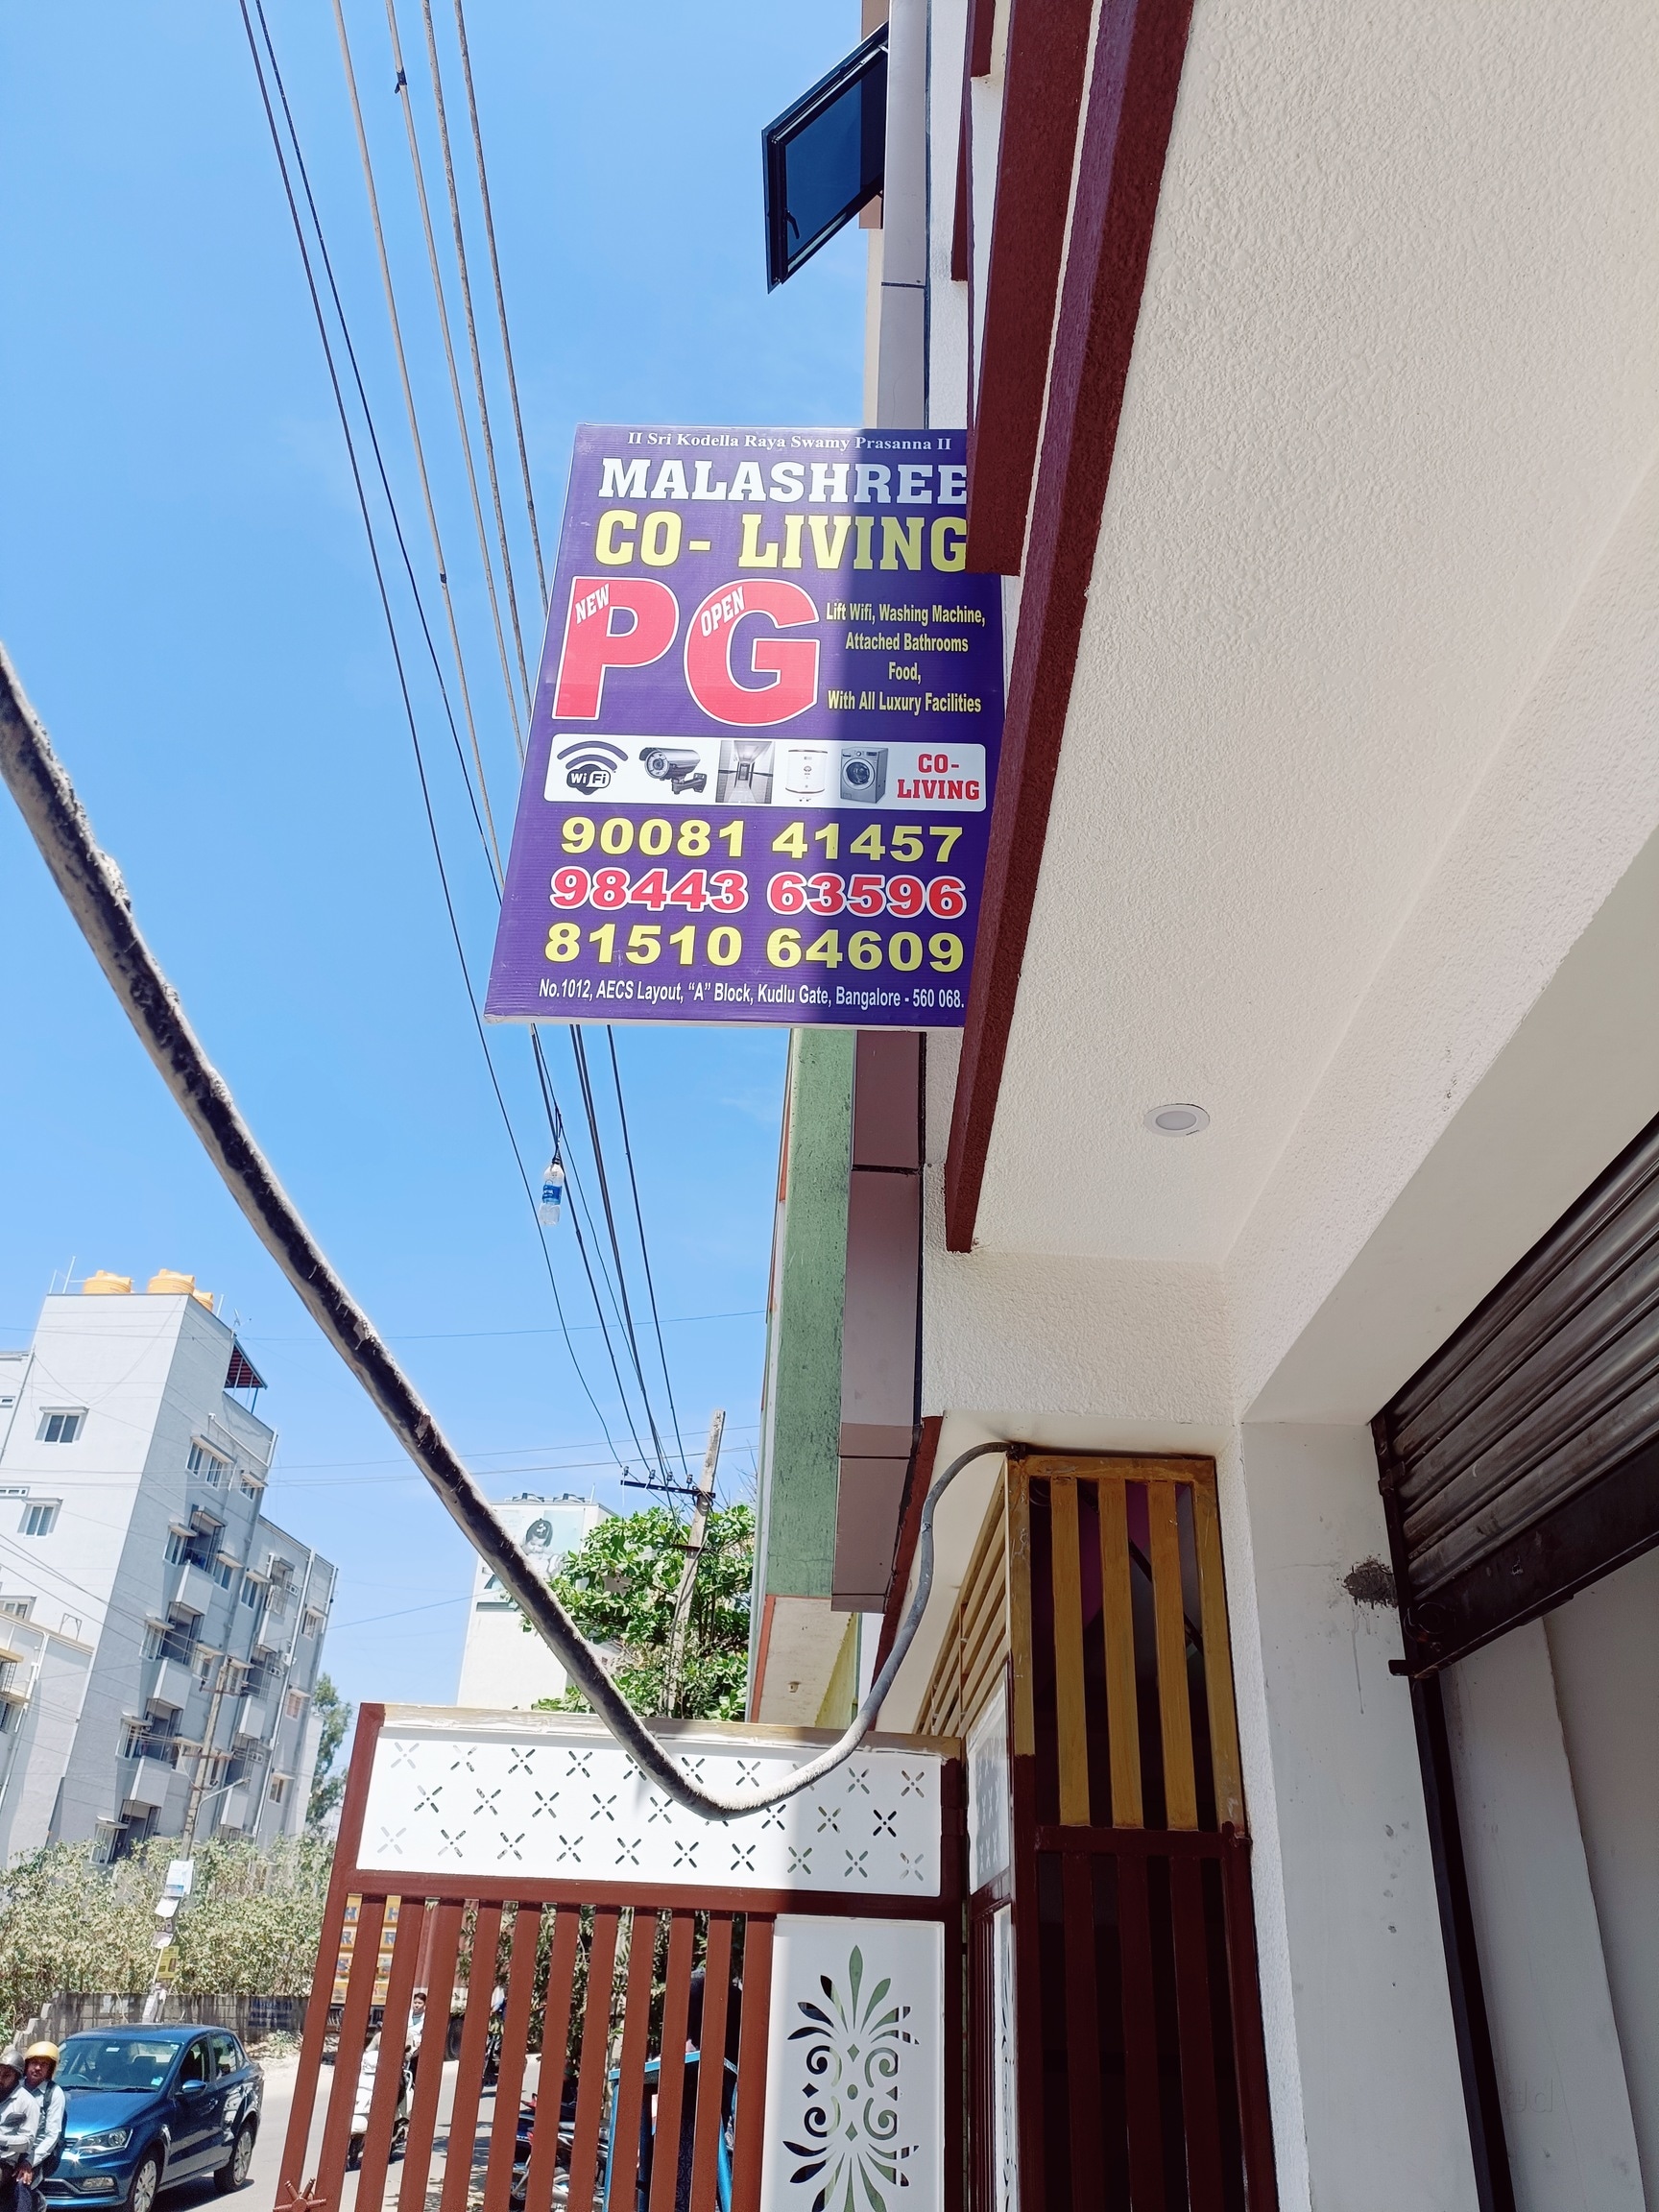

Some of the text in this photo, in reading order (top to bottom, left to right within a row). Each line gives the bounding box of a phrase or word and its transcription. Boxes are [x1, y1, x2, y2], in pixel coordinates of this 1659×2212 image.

[646, 432, 672, 446] Sri
[676, 433, 739, 447] Kodella
[744, 435, 786, 450] Raya
[790, 435, 851, 452] Swamy
[854, 437, 932, 451] Prasanna
[597, 457, 967, 504] MALASHREE
[737, 513, 967, 572] LIVING
[574, 583, 611, 625] NEW
[700, 585, 746, 637] OPEN
[826, 602, 986, 627] Lift Wifi, Washing Machine,
[551, 575, 821, 727] PG
[845, 631, 969, 653] Attached Bathrooms
[888, 661, 922, 685] Food,
[828, 690, 982, 716] With All Luxury Facilities
[918, 753, 960, 774] CO-
[897, 779, 979, 801] LIVING
[561, 816, 964, 863] 90081 41457
[549, 865, 967, 920] 98443 63596
[543, 922, 964, 973] 81510 64609
[539, 978, 593, 1001] No.1012,
[595, 979, 635, 999] AECS
[637, 981, 684, 1004] Layout,
[713, 982, 754, 1005] Block,
[757, 983, 795, 1004] Kudlu
[799, 985, 832, 1007] Gate,
[835, 986, 901, 1010] Bangalore
[912, 988, 935, 1008] 560
[938, 989, 965, 1008] 068.
